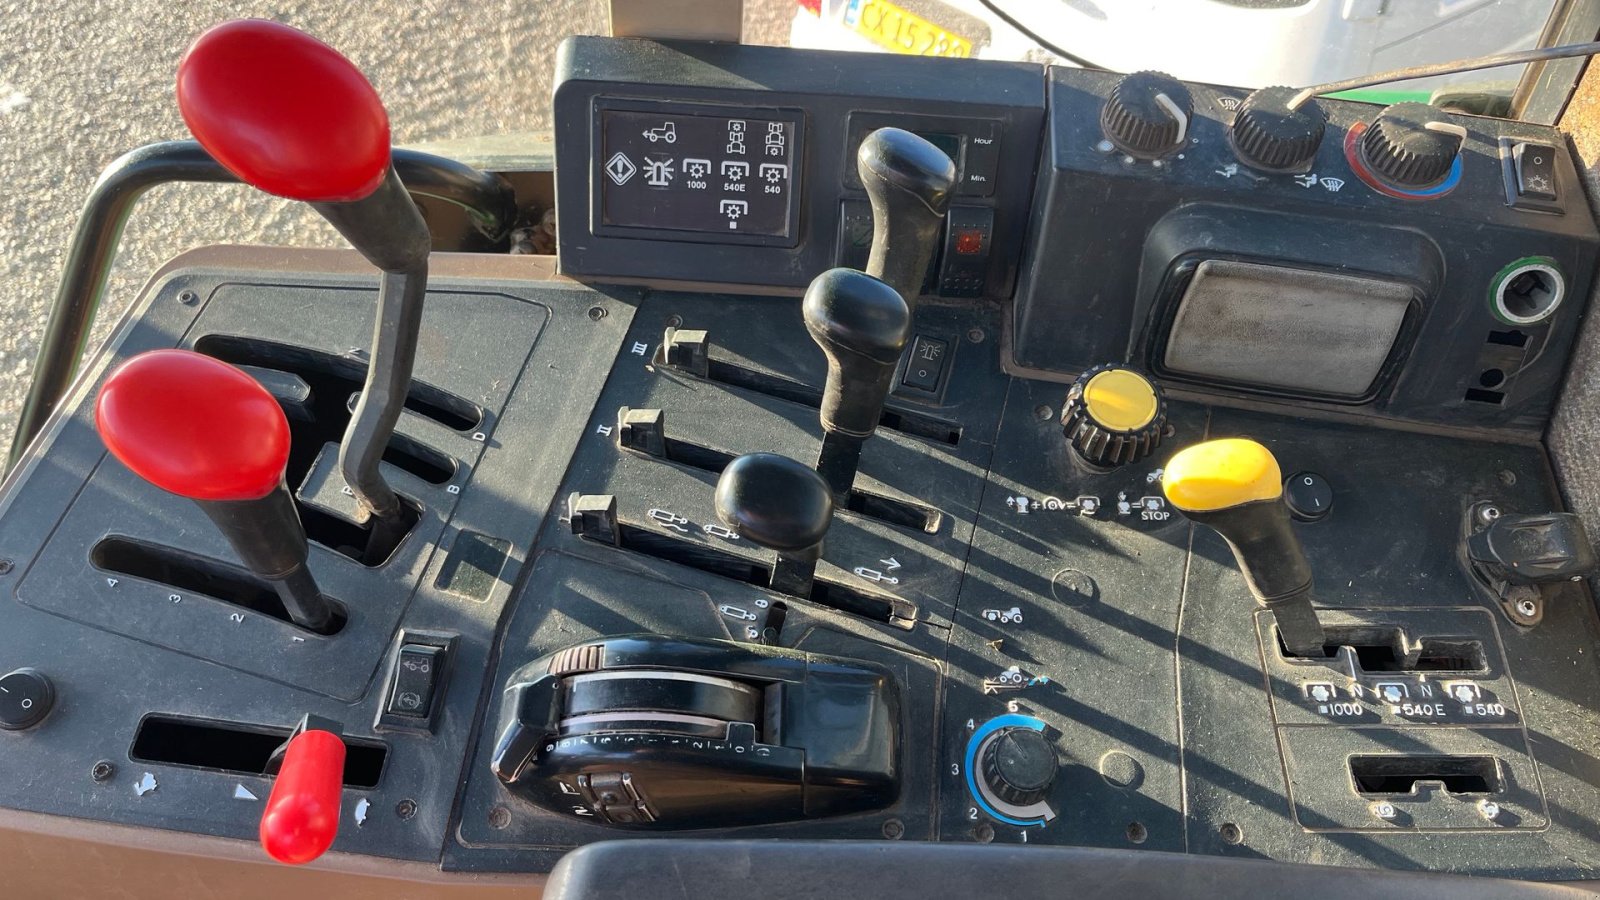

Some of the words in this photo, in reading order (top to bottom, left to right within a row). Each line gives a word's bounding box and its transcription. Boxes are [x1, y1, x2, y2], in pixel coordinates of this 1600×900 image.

[974, 137, 993, 145] Hour
[686, 180, 707, 190] 1000
[723, 183, 746, 192] 540E
[764, 185, 781, 194] 540
[472, 431, 486, 441] D
[447, 484, 460, 495] B
[1141, 511, 1170, 521] STOP
[107, 577, 119, 588] 4
[169, 593, 182, 604] 3
[230, 613, 245, 623] 2
[1421, 685, 1433, 697] N
[1008, 701, 1019, 712] 5
[1330, 704, 1363, 716] 1000
[1476, 704, 1506, 716] 540
[967, 718, 975, 730] 4
[951, 763, 960, 775] 3
[969, 807, 978, 820] 2
[1020, 830, 1028, 843] 1
